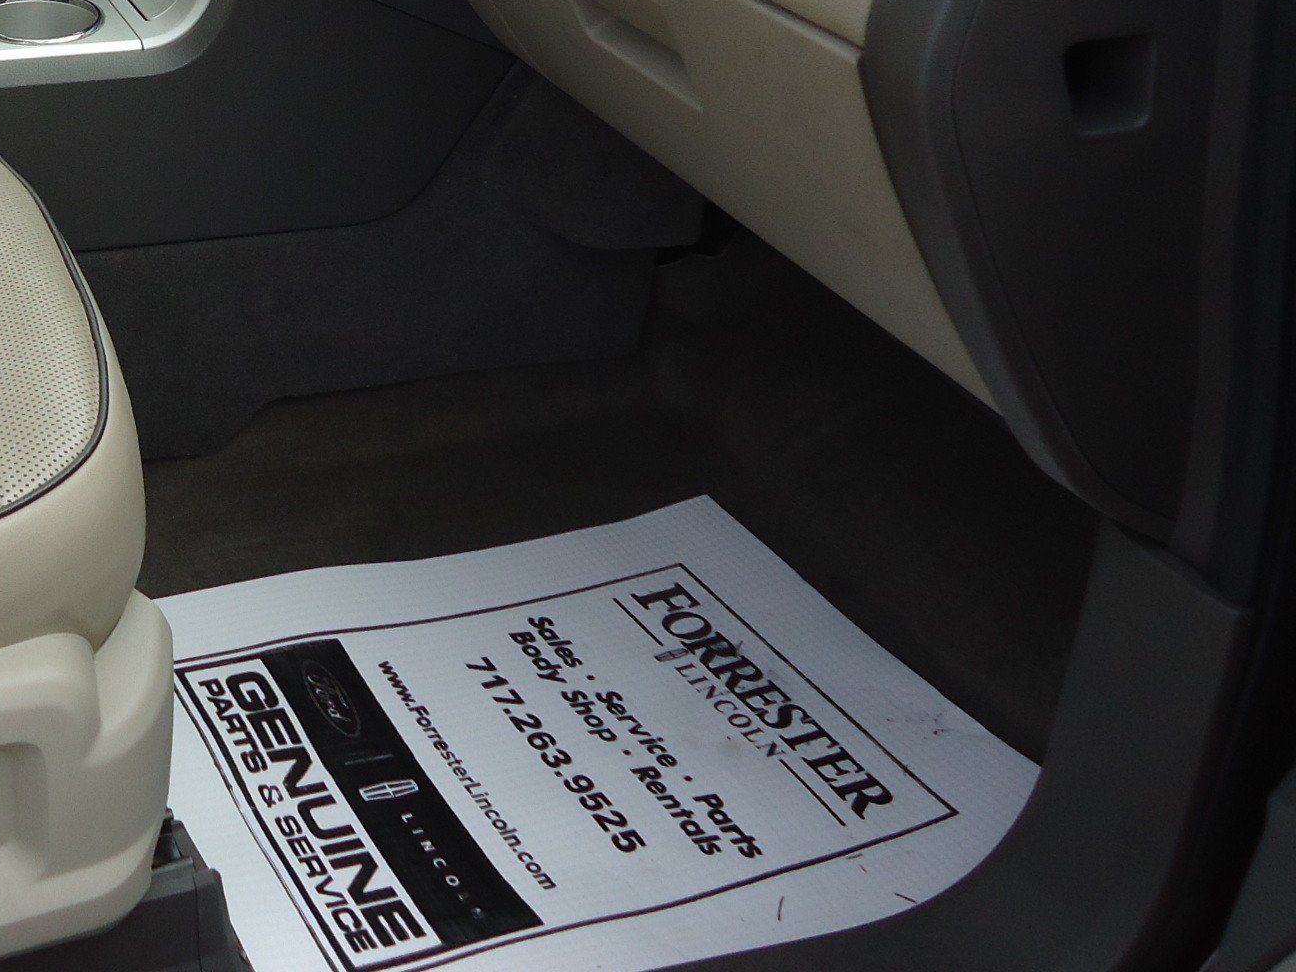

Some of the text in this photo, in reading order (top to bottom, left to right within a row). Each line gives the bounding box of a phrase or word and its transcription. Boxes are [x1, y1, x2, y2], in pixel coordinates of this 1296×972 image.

[198, 678, 379, 953] PARTS & SERVICE
[225, 671, 427, 948] GENUINE
[378, 660, 557, 891] www.ForresterLincoln.com
[464, 656, 647, 854] 717.263.9525
[508, 631, 722, 856] Body Shop Rentals
[527, 616, 763, 859] Sales Service Parts
[630, 582, 894, 820] FORRESTER
[674, 662, 786, 758] LINCOLN
[400, 810, 486, 920] LINCO
